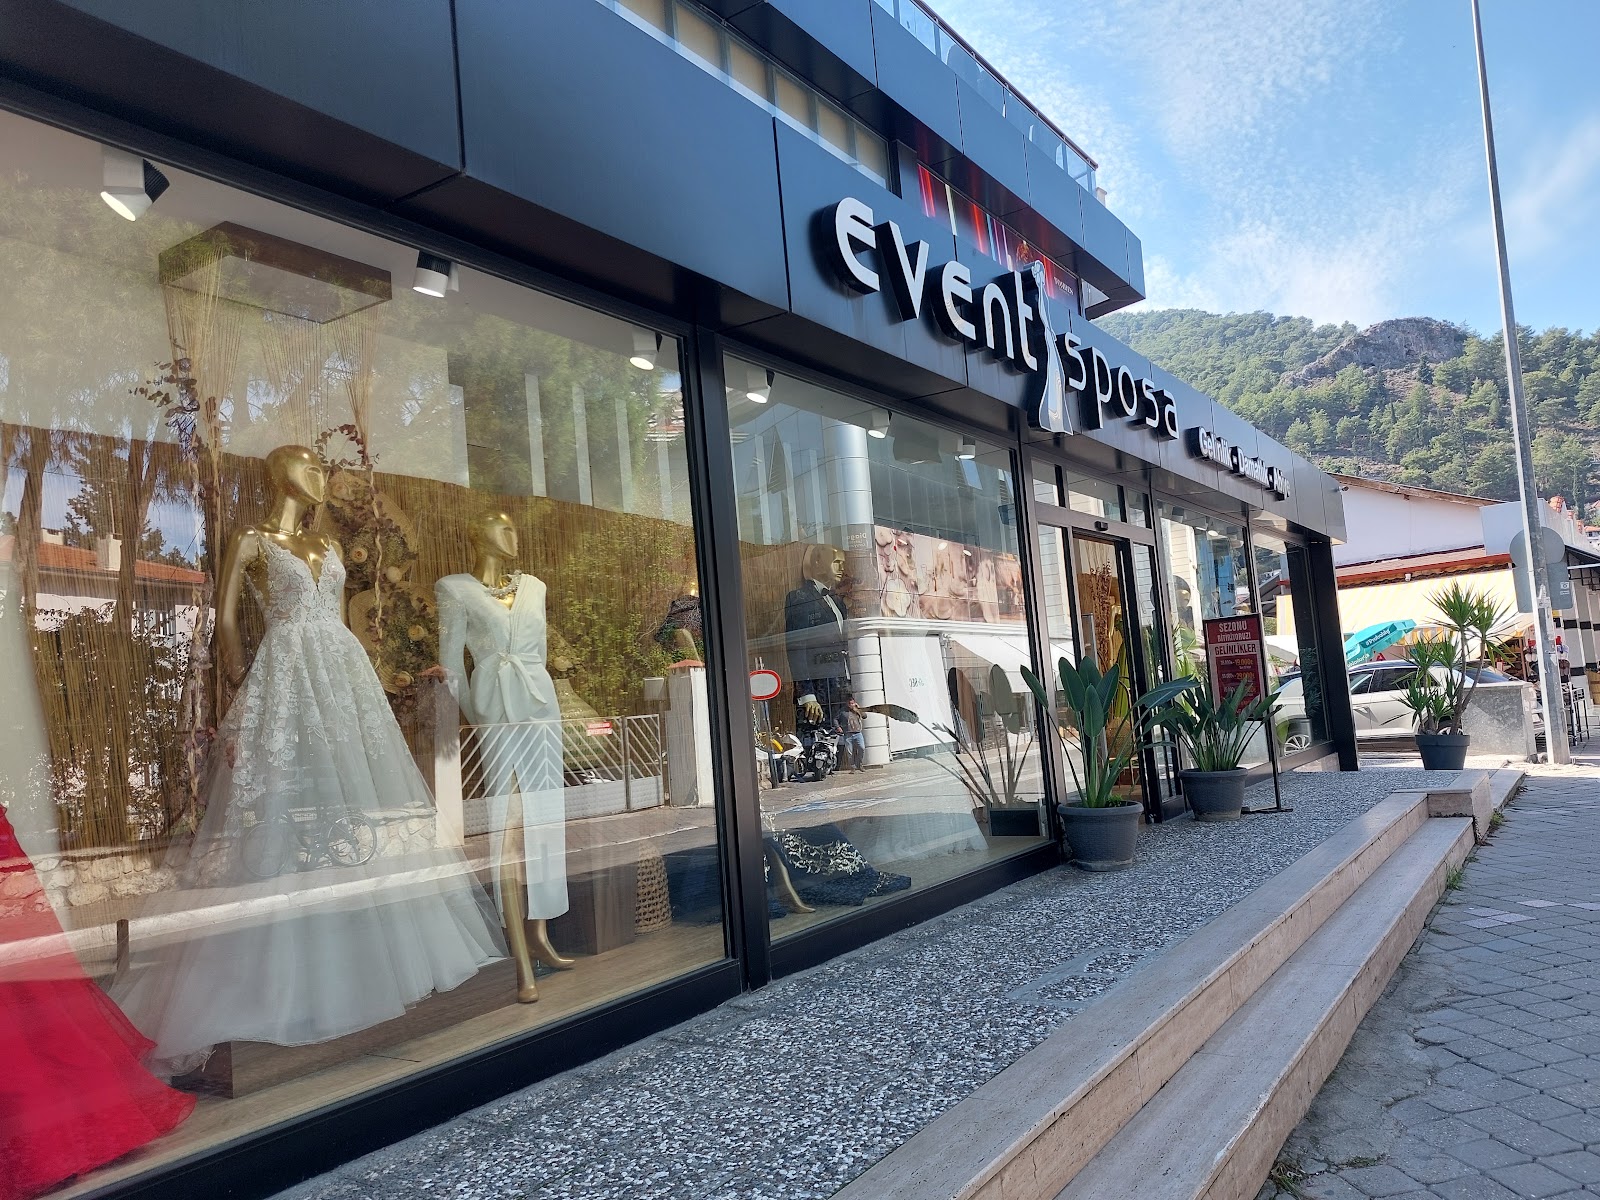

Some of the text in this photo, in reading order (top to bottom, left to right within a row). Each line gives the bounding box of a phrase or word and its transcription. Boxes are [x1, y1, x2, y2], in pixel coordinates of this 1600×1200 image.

[1064, 331, 1180, 440] sposa
[1199, 426, 1233, 470] Gelinlik
[1218, 620, 1247, 632] SEZONU
[1215, 643, 1256, 655] GELİNLİKLER
